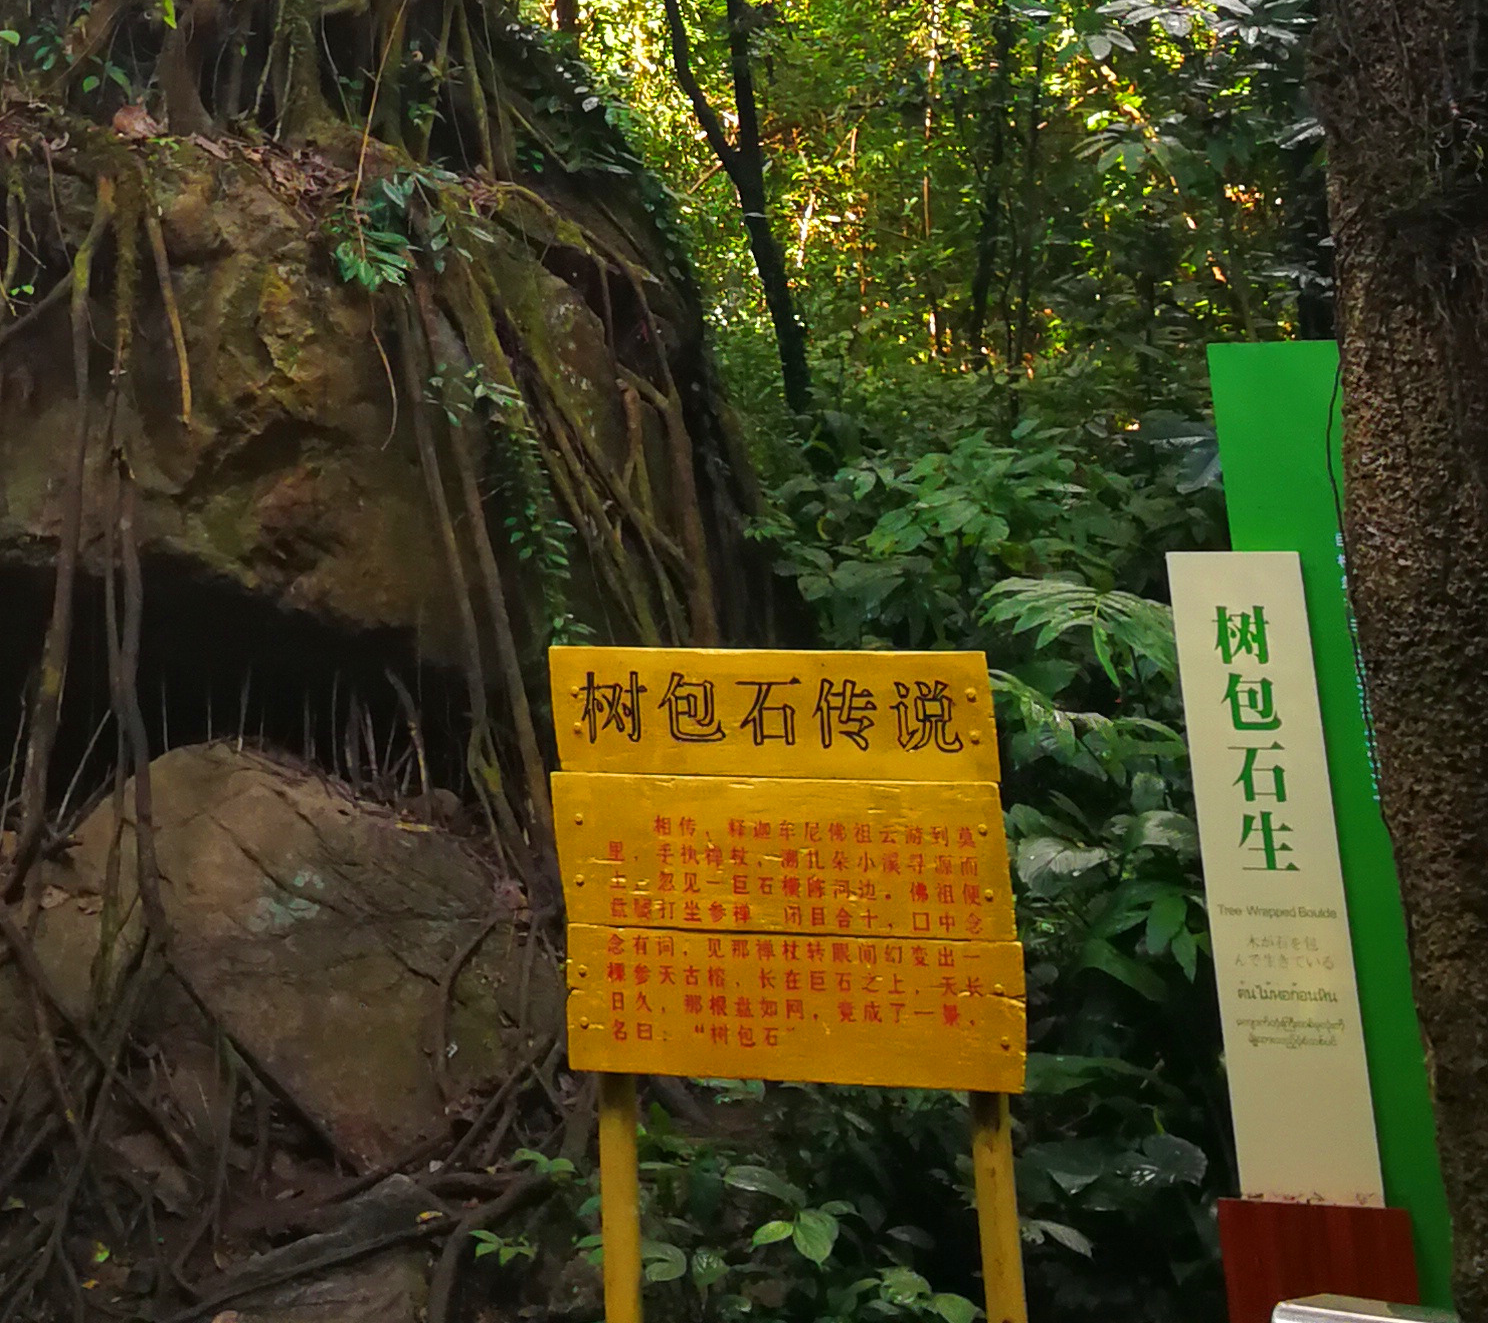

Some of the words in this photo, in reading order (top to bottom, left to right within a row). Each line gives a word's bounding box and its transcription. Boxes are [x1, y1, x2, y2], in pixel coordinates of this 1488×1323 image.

[579, 671, 964, 753] 树包石传说
[1212, 605, 1301, 874] 树包石生
[1217, 904, 1242, 916] Tree
[1246, 905, 1296, 919] Wrapped
